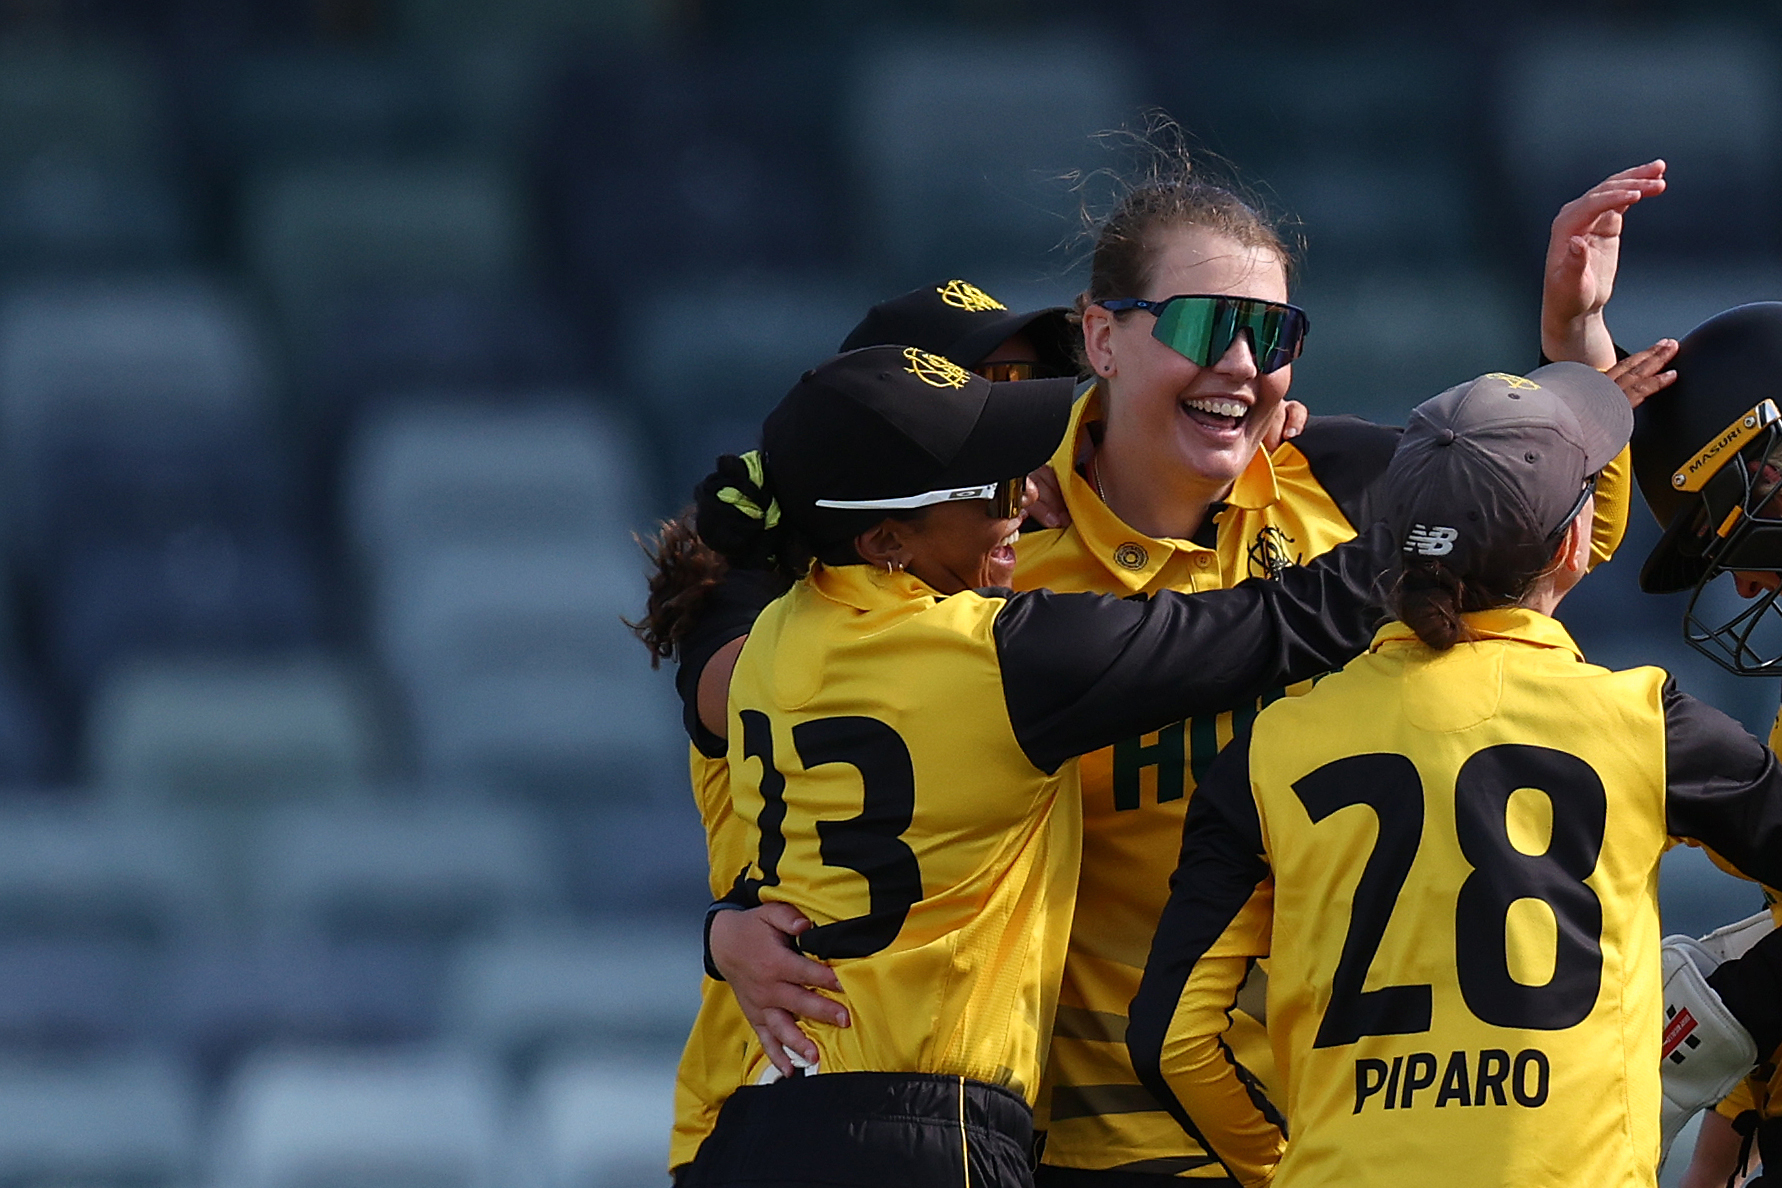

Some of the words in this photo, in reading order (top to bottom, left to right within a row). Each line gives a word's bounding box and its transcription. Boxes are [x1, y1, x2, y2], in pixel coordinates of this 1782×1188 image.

[1688, 426, 1744, 475] MASURI
[738, 708, 924, 961] 13
[1290, 743, 1608, 1049] 28
[1351, 1048, 1550, 1116] PIPARO
